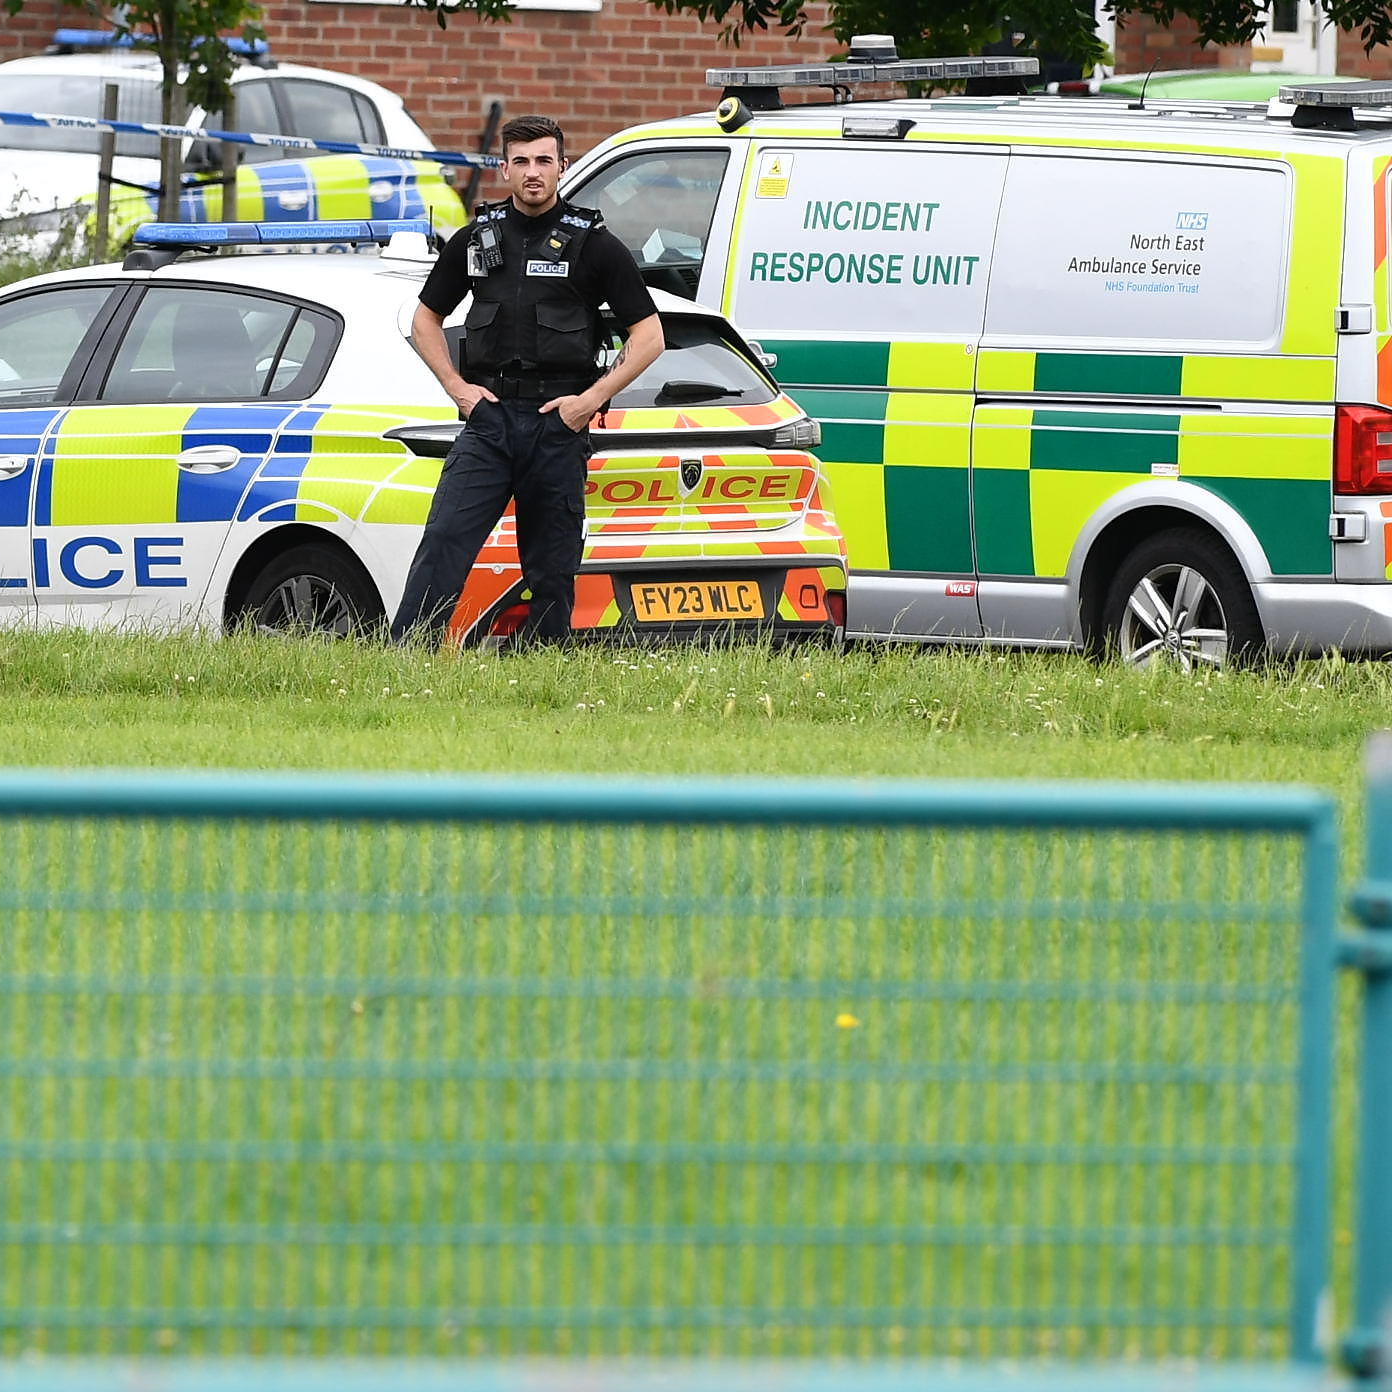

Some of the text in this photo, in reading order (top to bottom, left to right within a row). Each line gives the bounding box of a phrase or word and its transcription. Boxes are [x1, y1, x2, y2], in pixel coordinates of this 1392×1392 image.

[803, 200, 940, 232] INCIDENT
[1177, 212, 1208, 229] NHS
[1130, 234, 1205, 251] North East
[530, 263, 565, 273] POLICE
[750, 251, 980, 285] RESPONSE UNIT
[1067, 257, 1201, 276] Ambulance Service
[1104, 281, 1199, 293] NHS Foundation Trust
[949, 584, 972, 594] WAS
[642, 585, 753, 615] FY23 WLC
